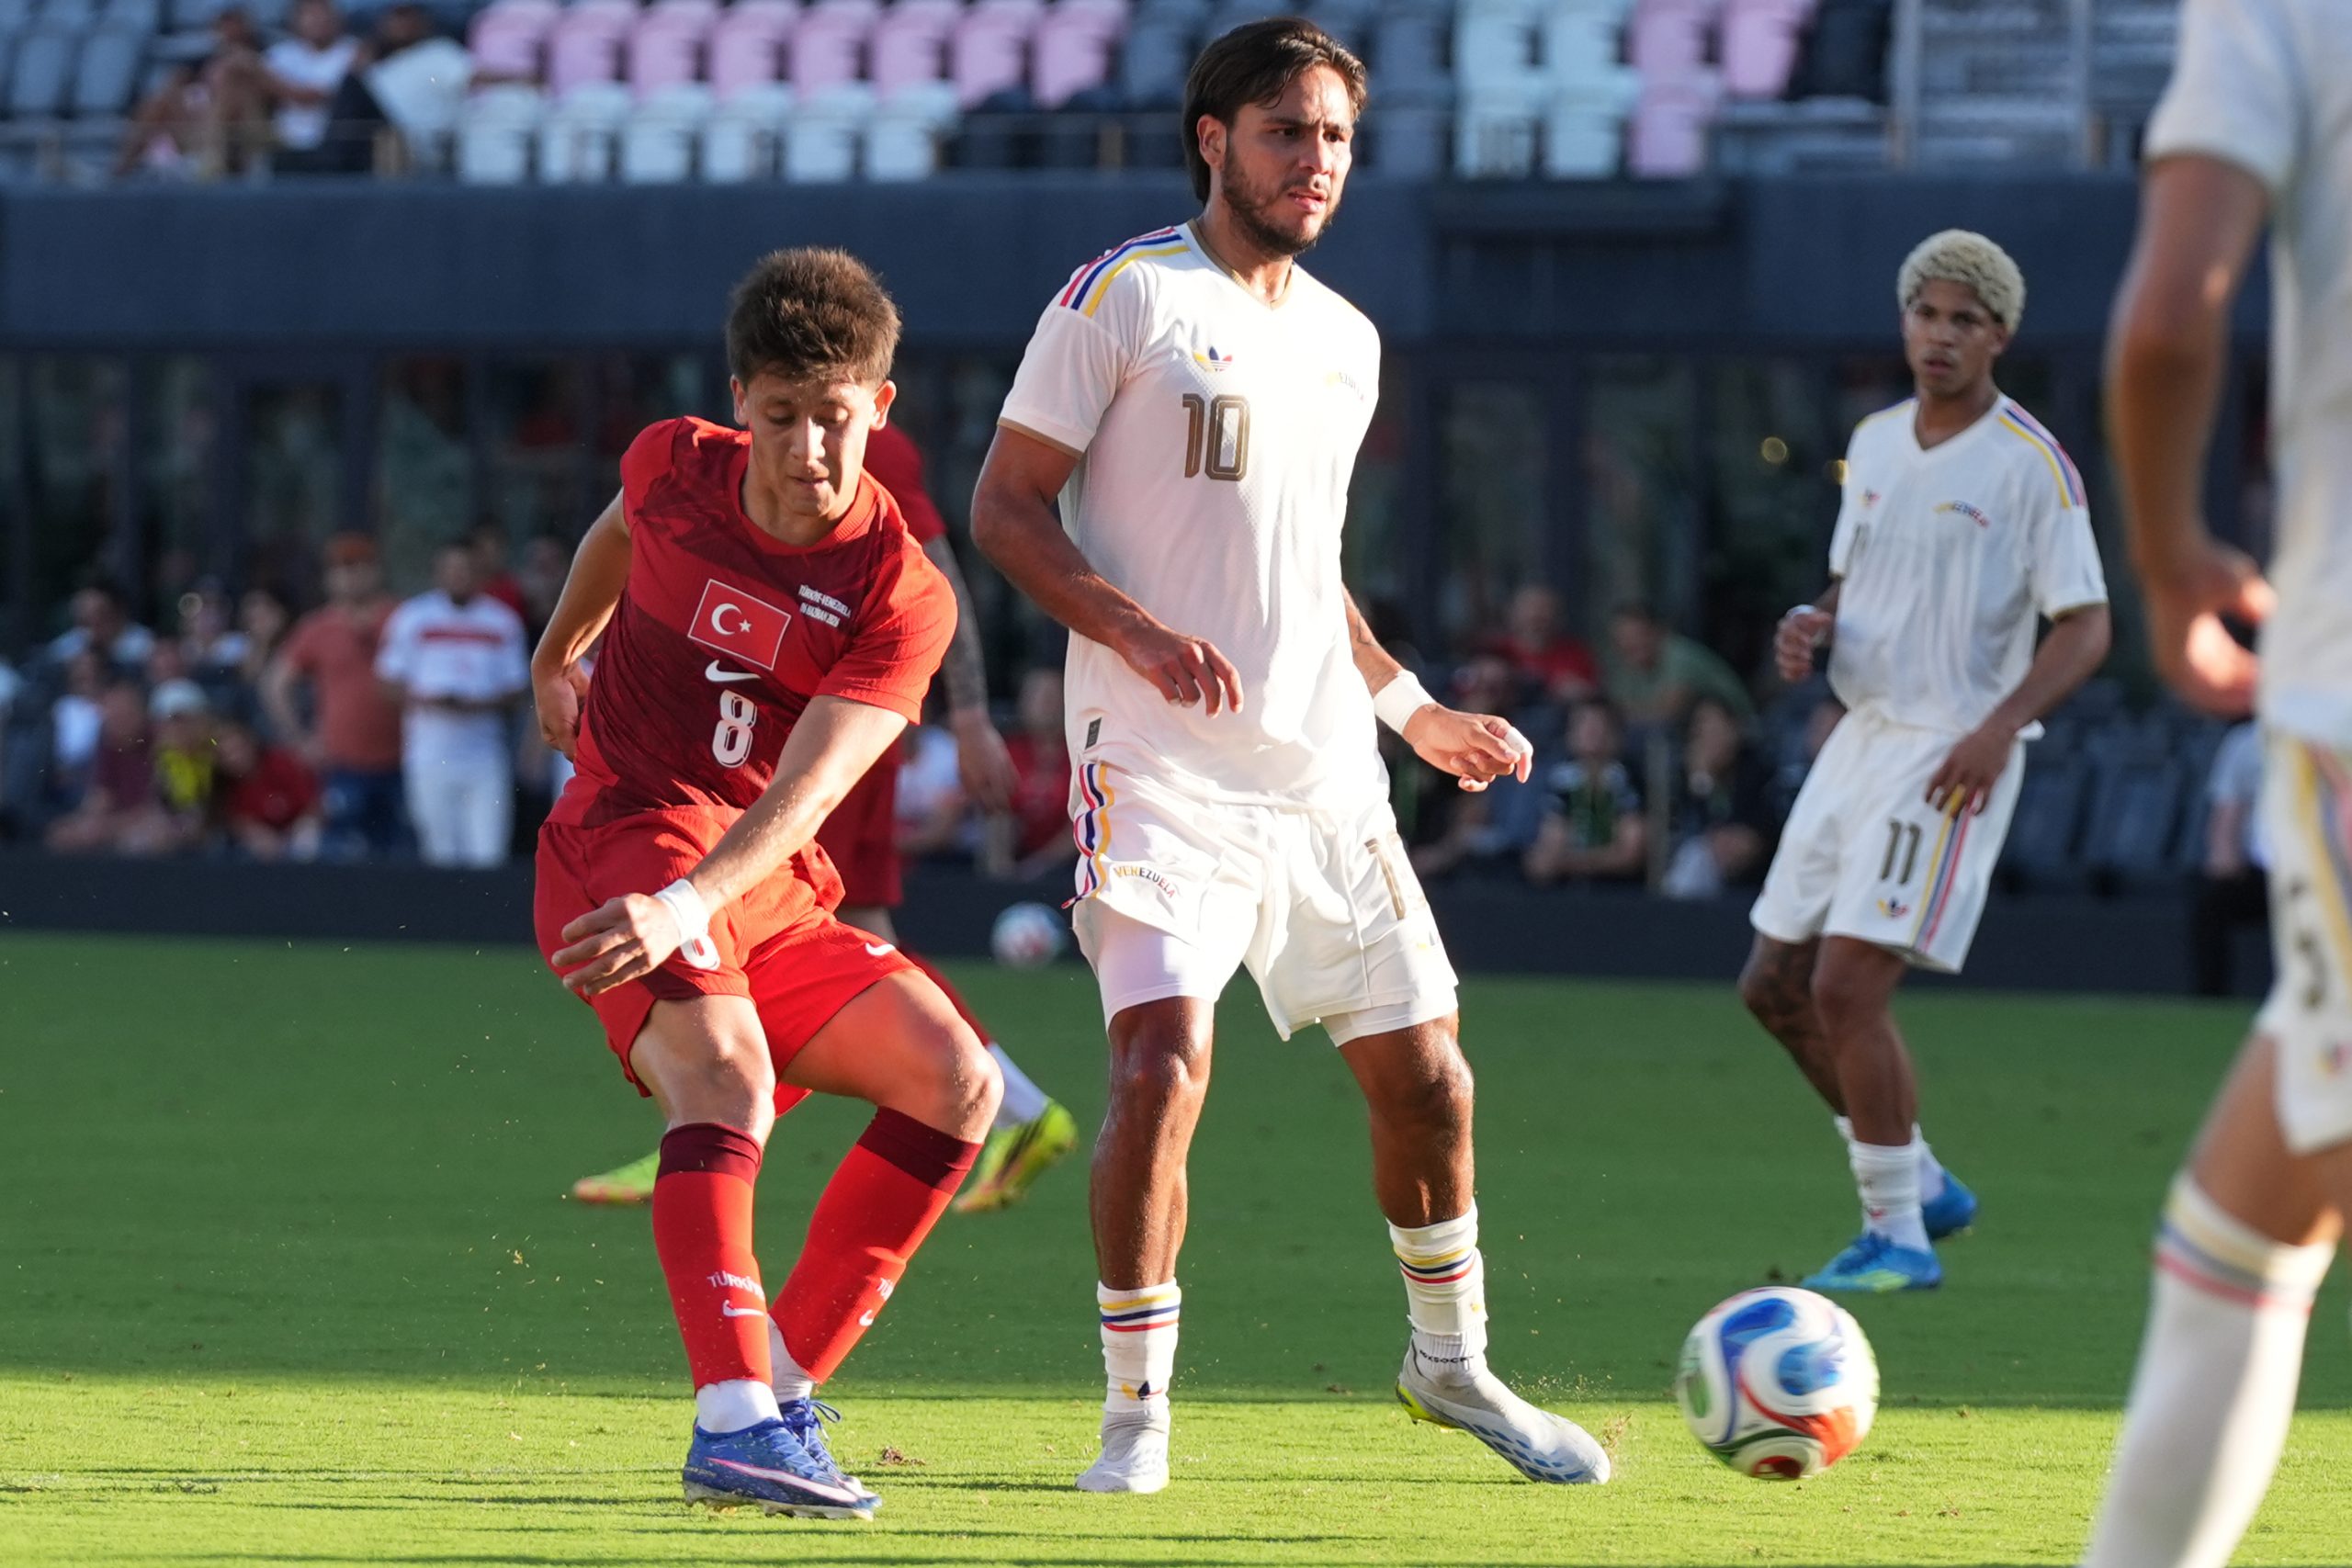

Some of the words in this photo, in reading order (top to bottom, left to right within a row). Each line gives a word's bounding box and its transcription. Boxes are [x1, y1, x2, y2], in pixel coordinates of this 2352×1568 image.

[1182, 393, 1250, 481] 10
[712, 689, 757, 768] 8
[1113, 865, 1175, 898] VENEZUELA
[1879, 819, 1921, 885] 11
